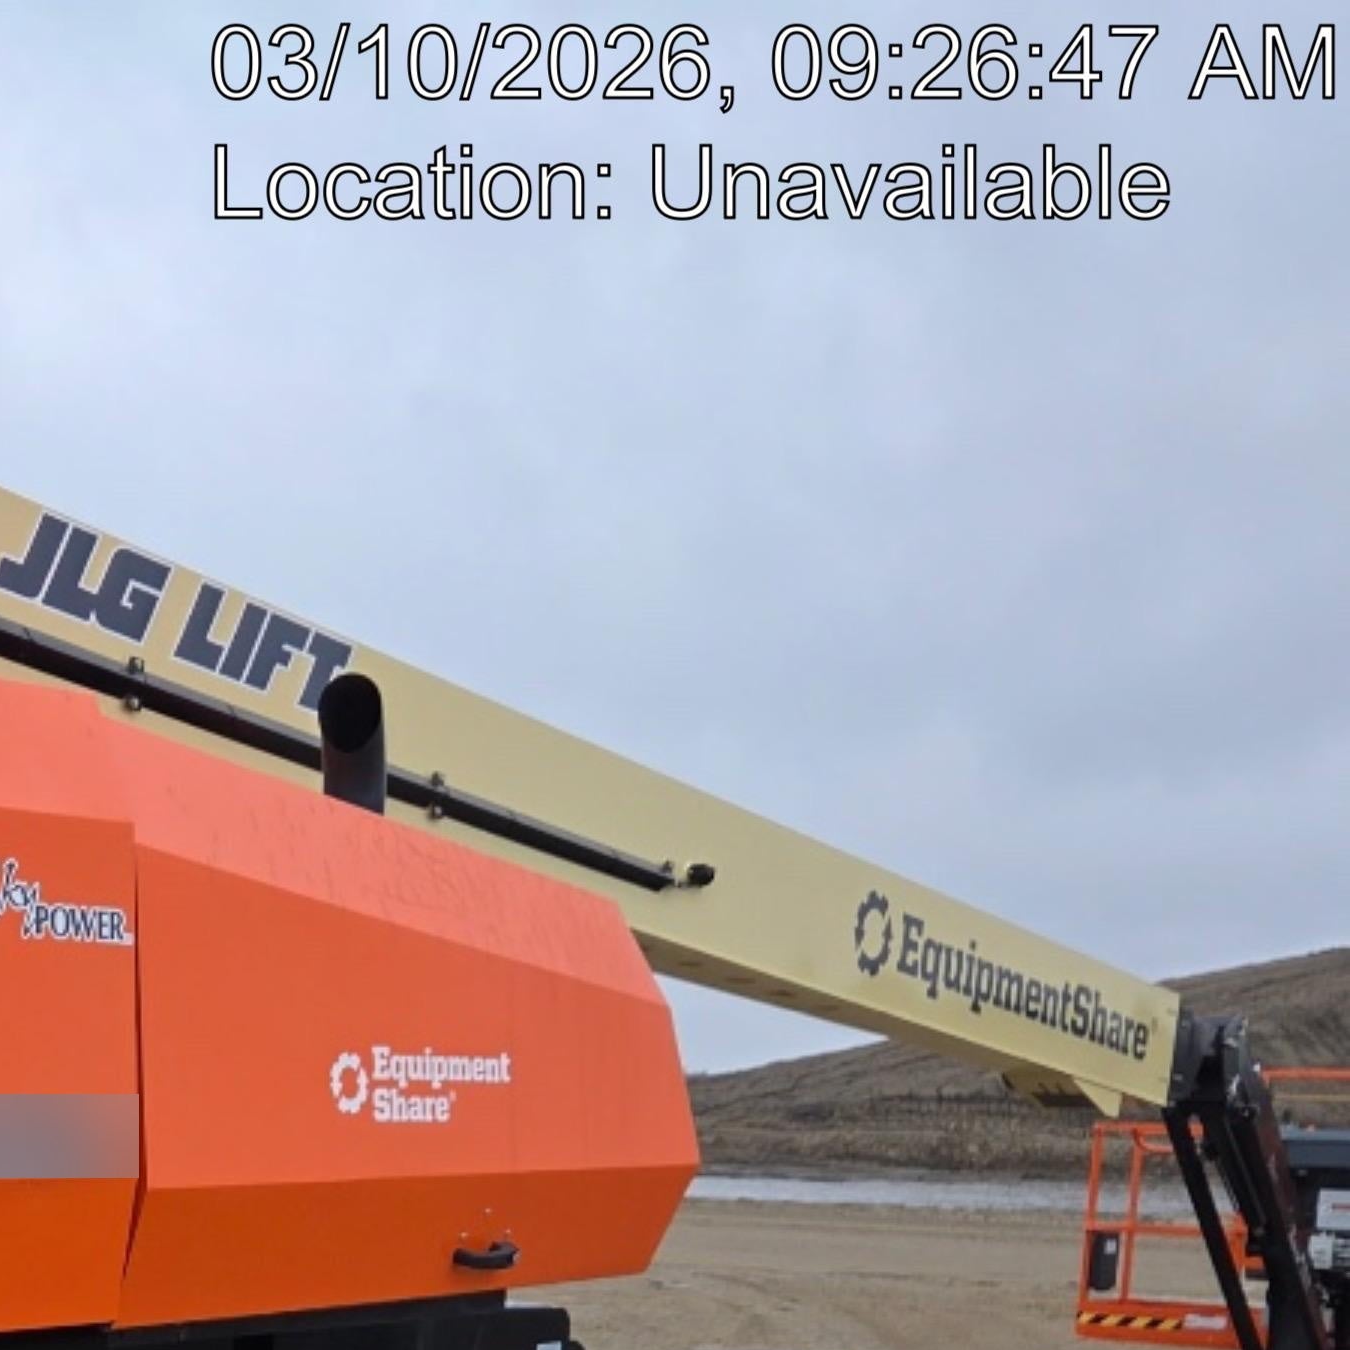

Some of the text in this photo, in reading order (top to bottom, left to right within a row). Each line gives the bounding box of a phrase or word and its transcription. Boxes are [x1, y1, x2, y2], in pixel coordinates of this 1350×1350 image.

[171, 577, 355, 713] LIFT
[896, 911, 1149, 1061] EquipmentShare
[371, 1045, 511, 1090] Equipment
[372, 1087, 450, 1123] Share
